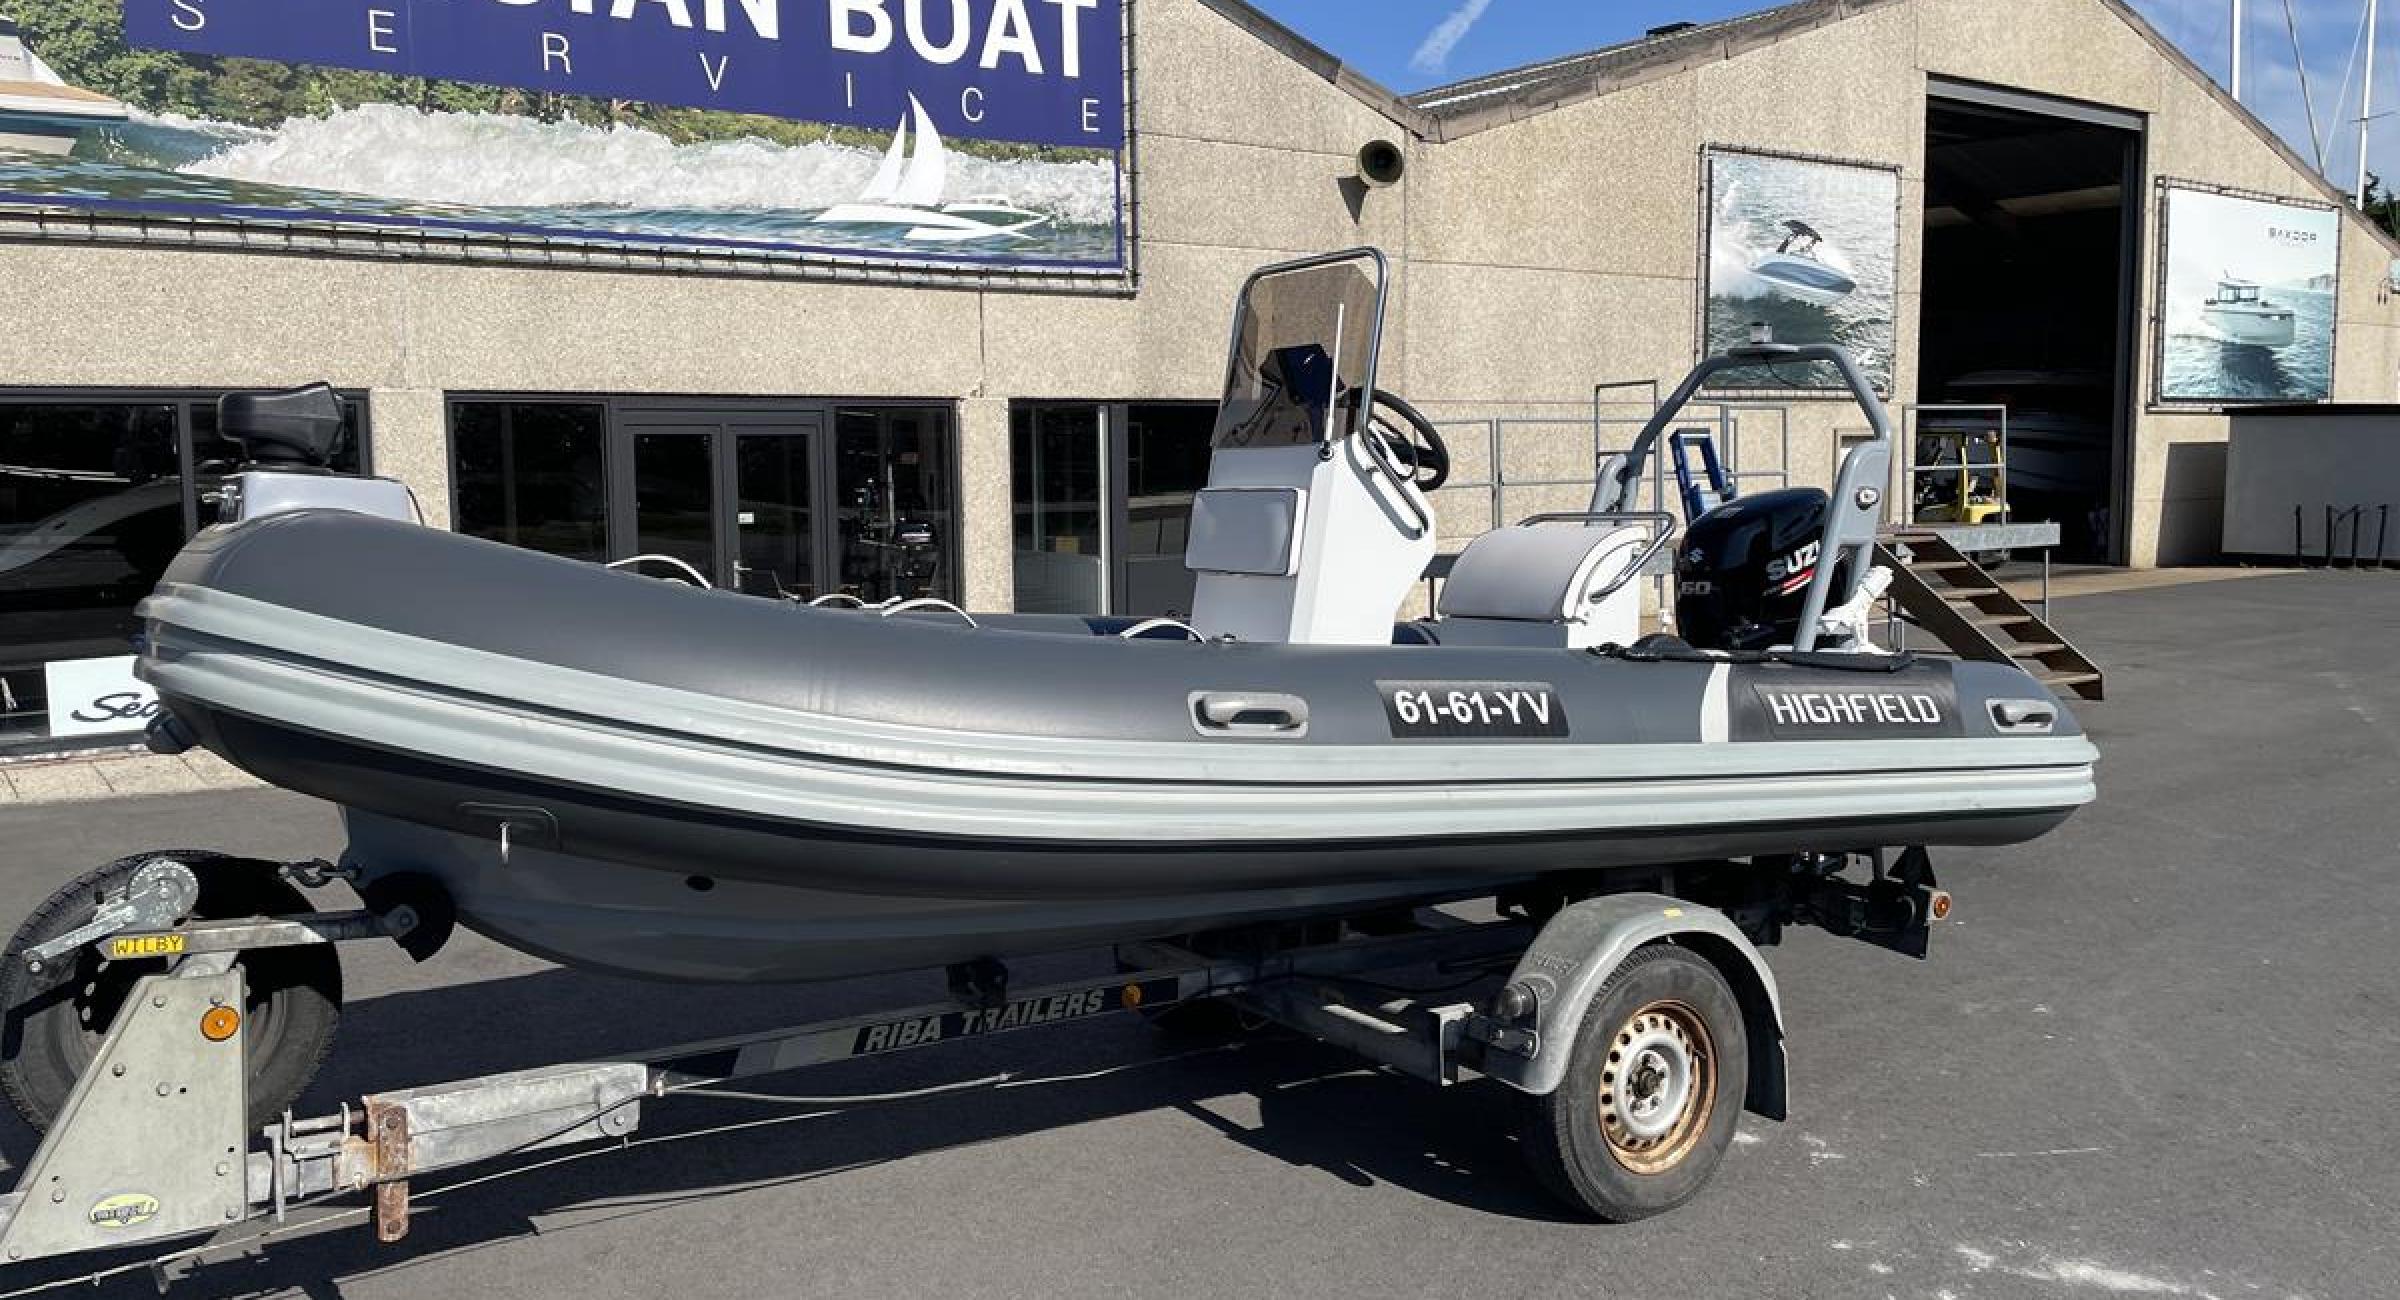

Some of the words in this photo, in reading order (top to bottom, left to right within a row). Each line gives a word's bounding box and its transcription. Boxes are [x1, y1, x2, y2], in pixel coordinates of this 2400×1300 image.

[830, 0, 1097, 78] BOAT
[1395, 689, 1549, 724] 61-61-YV
[1768, 693, 1941, 724] HIGHFIELD
[114, 934, 184, 954] WILBY
[864, 1015, 941, 1051] RIBA
[960, 988, 1105, 1035] TRAILERS
